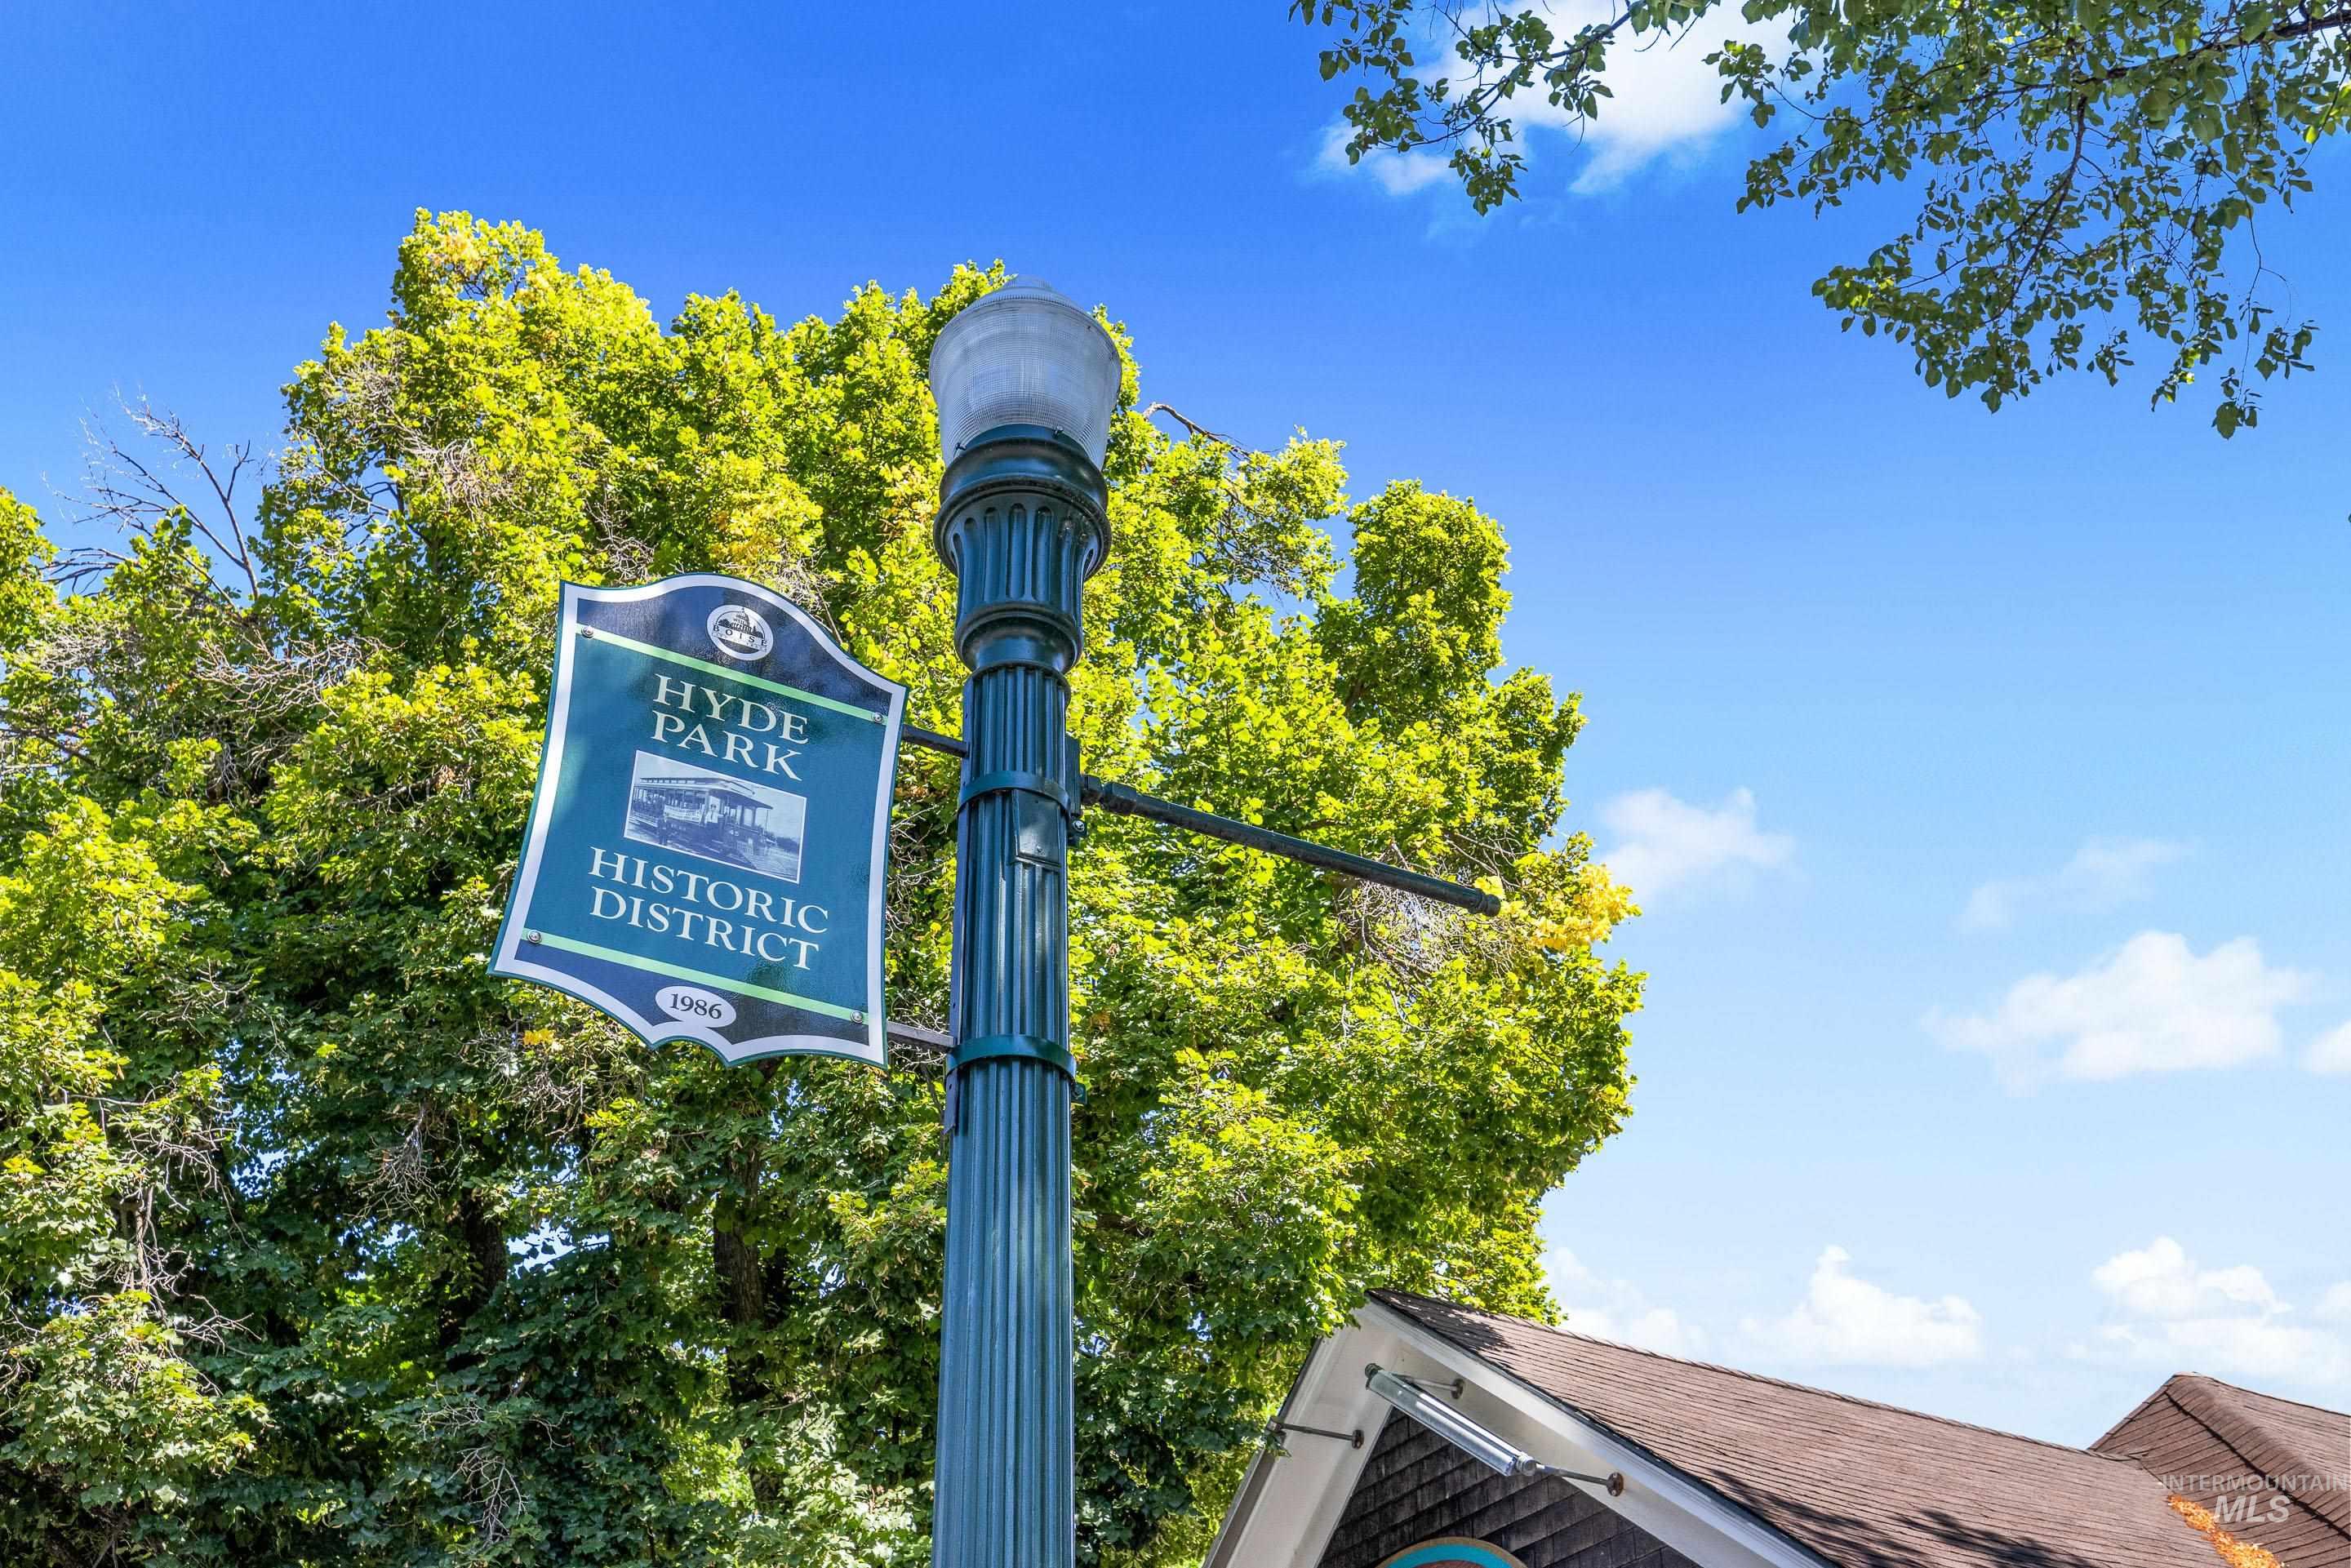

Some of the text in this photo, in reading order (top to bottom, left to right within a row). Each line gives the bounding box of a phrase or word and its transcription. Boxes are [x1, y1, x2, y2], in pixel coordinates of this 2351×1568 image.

[713, 624, 767, 647] BOISE
[653, 673, 809, 744] HYDE
[651, 709, 802, 781] PARK
[588, 846, 829, 934] HISTORIC
[589, 886, 820, 971] DISTRICT
[669, 993, 722, 1019] 1986
